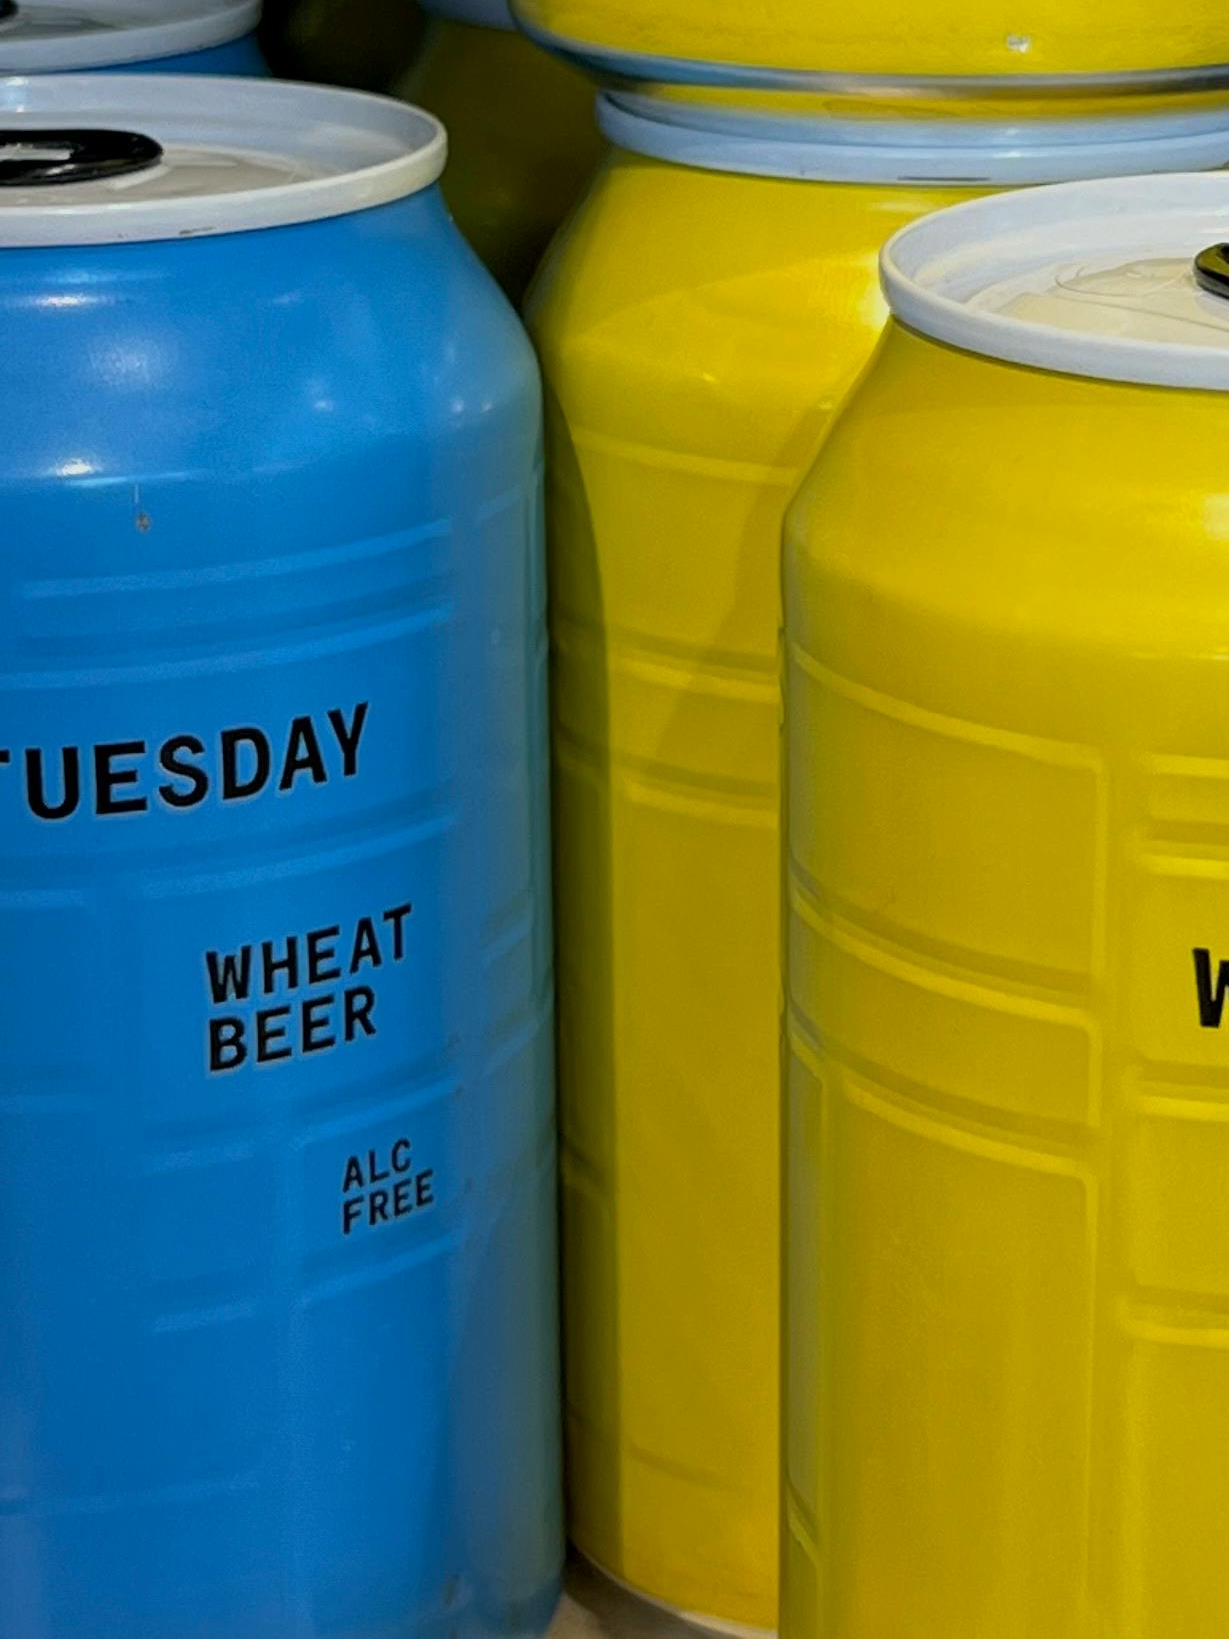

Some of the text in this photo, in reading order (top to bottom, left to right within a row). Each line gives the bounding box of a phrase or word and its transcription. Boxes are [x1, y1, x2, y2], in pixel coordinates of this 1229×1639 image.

[0, 701, 369, 820] UESDAY
[204, 903, 412, 1004] WHEAT
[209, 986, 377, 1072] BEER
[341, 1138, 412, 1193] ALC
[341, 1169, 434, 1235] FREE
